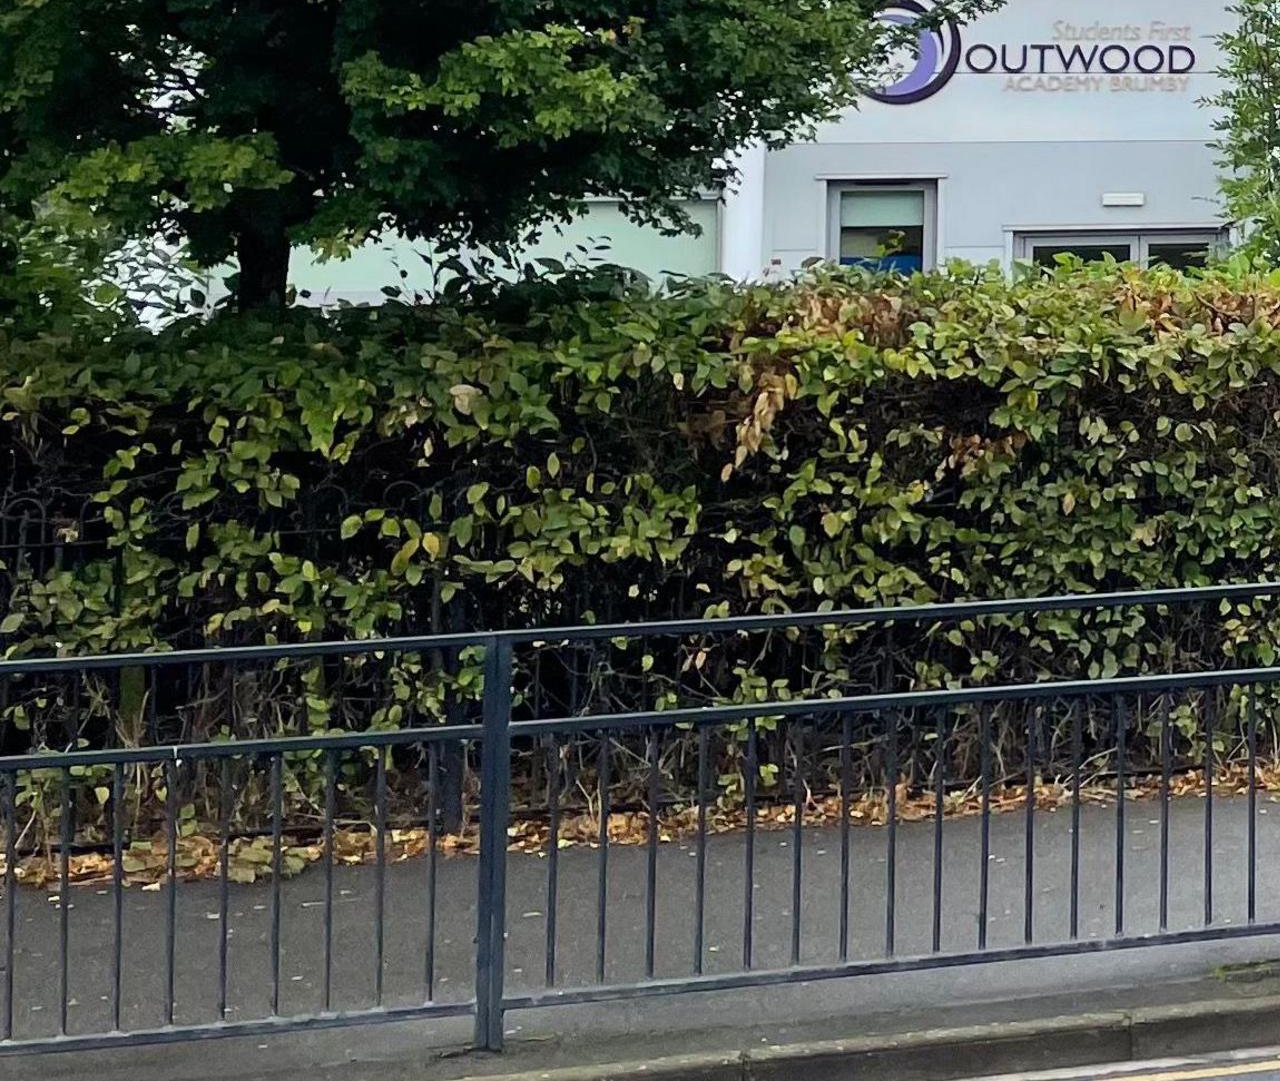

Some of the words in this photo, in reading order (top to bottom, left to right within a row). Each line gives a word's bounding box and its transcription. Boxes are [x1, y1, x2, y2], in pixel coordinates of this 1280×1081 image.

[1052, 20, 1141, 41] Students
[1148, 20, 1191, 41] First
[965, 43, 1196, 74] OUTWOOD
[1003, 76, 1100, 92] ACADEMY
[1109, 76, 1190, 92] BRUMBY
